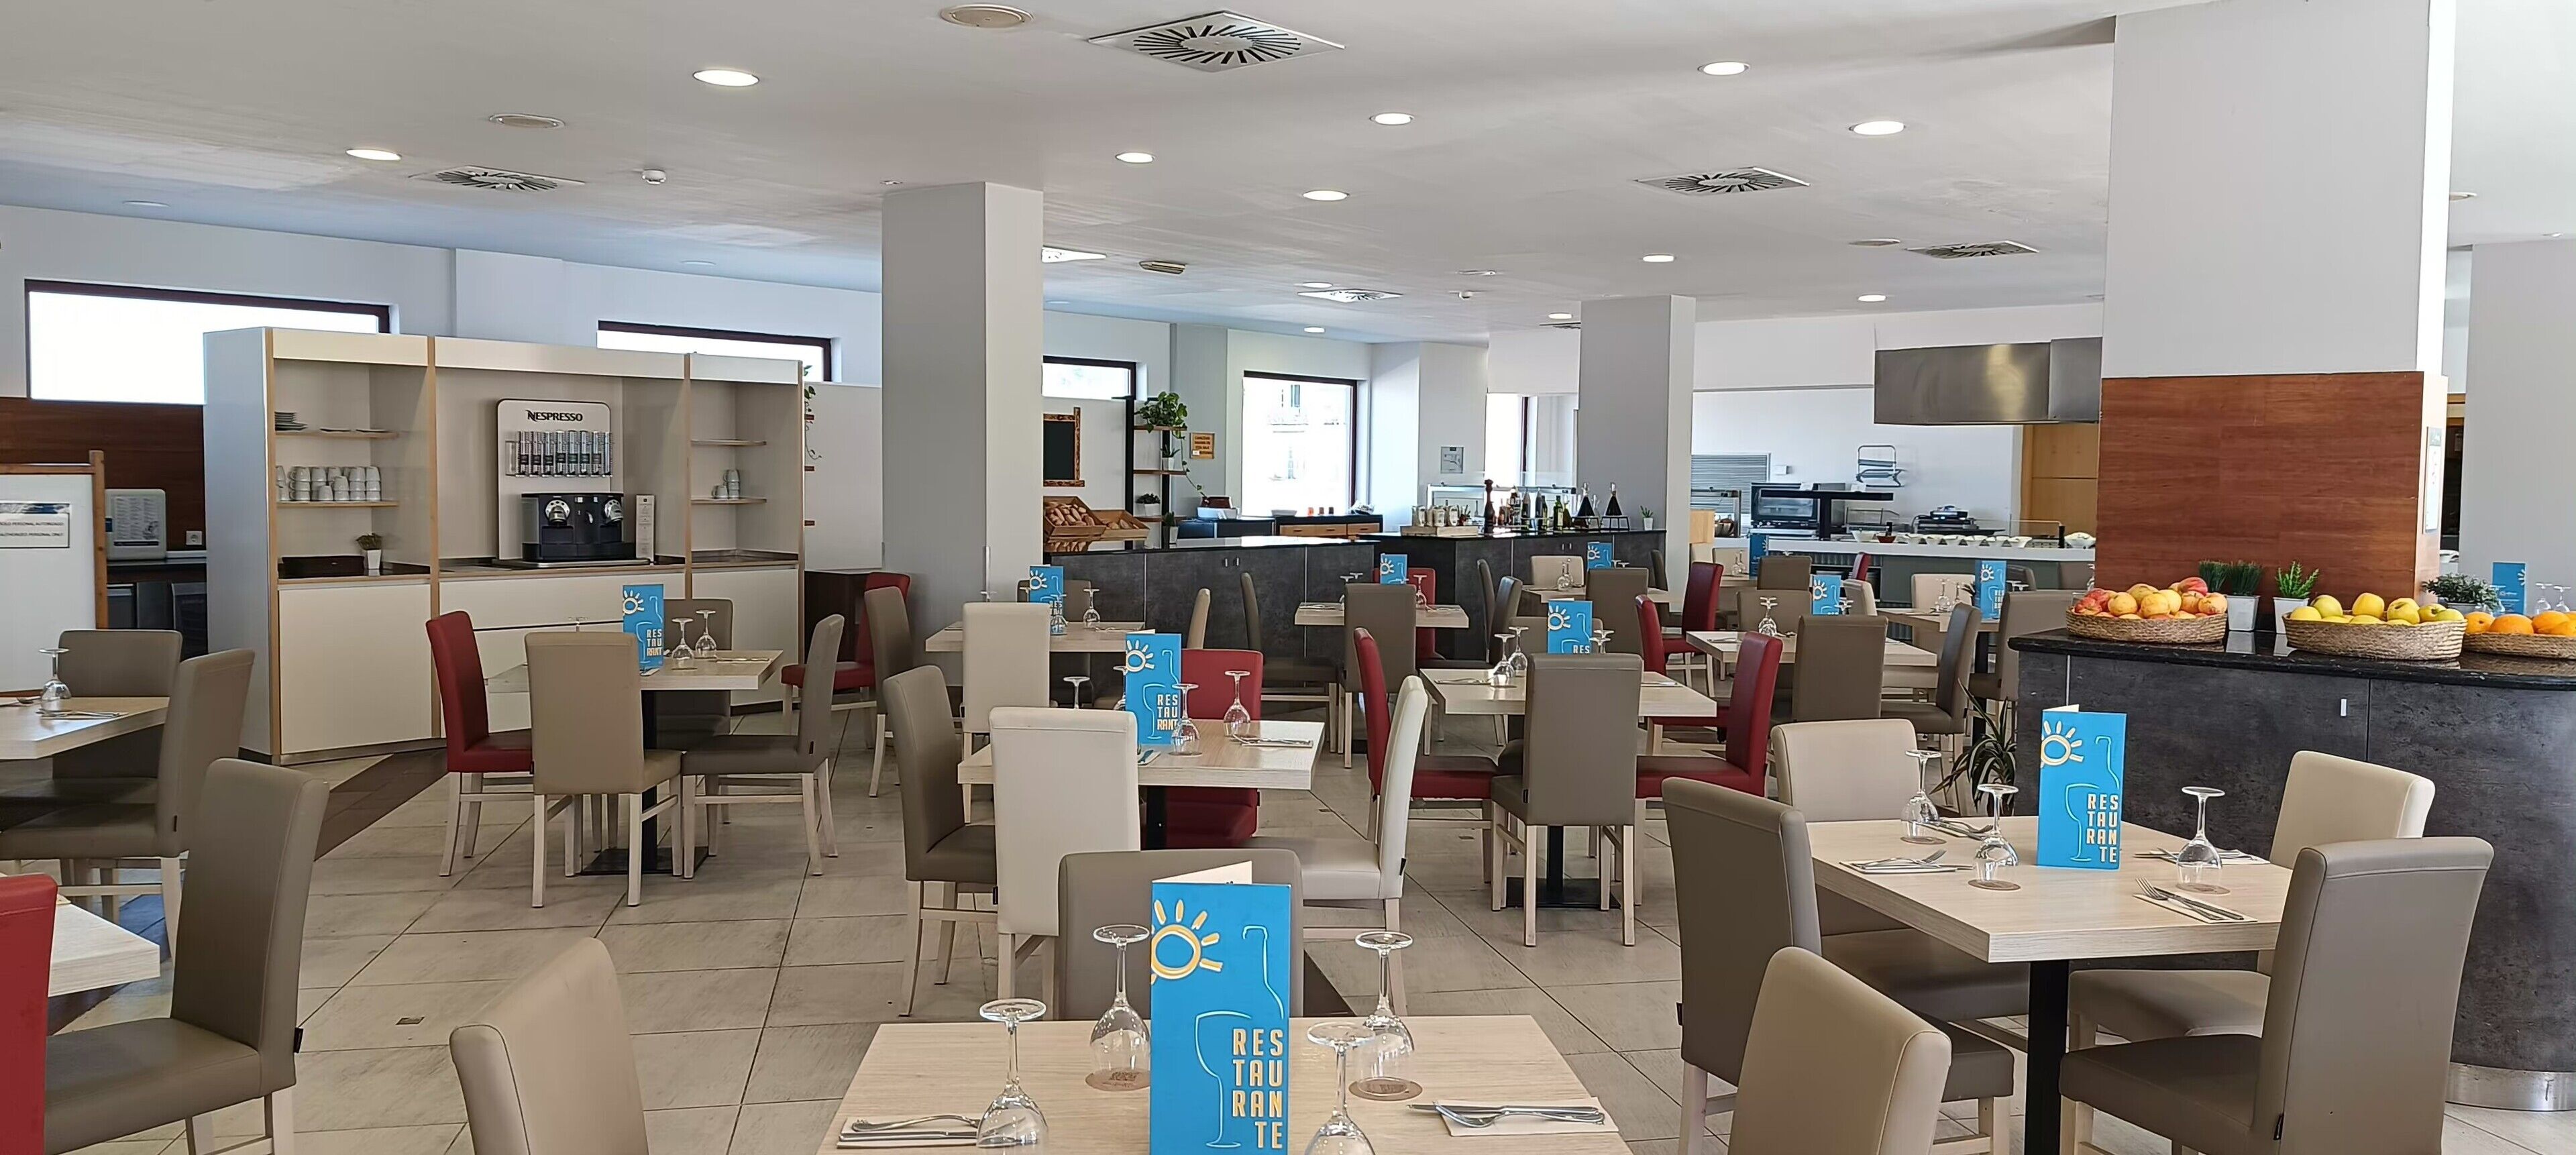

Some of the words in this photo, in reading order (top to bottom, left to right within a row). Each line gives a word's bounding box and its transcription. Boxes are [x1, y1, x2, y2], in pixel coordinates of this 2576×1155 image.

[525, 409, 583, 422] NESPRESSO
[647, 628, 662, 638] RES
[647, 638, 662, 647] TAU
[1573, 645, 1590, 654] RES
[1157, 694, 1178, 706] RES
[1157, 706, 1178, 718] TAU
[2087, 793, 2118, 810] RES
[2087, 811, 2118, 828] TAU
[2086, 828, 2117, 845] RAN
[2099, 846, 2117, 863] TE
[1233, 1028, 1283, 1056] RES
[1232, 1060, 1283, 1087] TAU
[1232, 1090, 1283, 1117] RAN
[1254, 1121, 1283, 1148] TE
